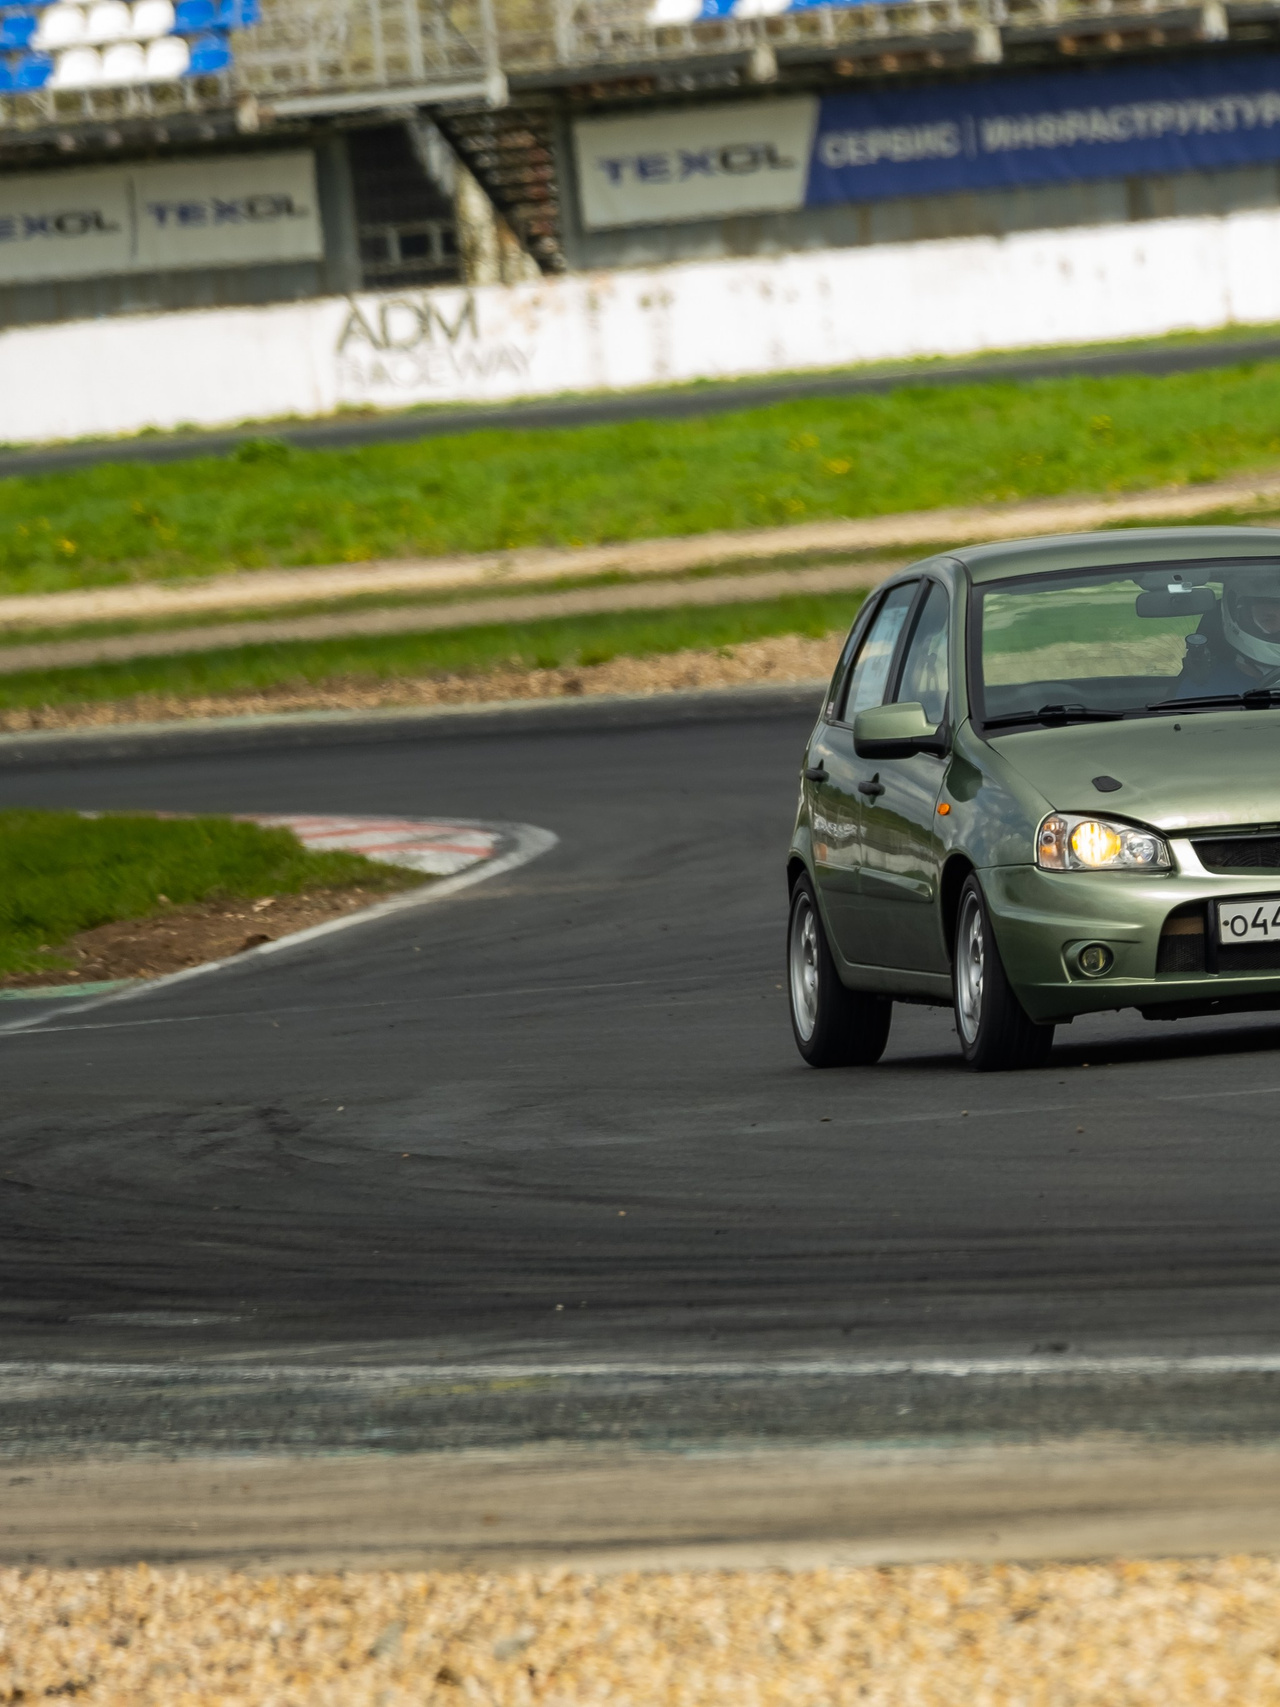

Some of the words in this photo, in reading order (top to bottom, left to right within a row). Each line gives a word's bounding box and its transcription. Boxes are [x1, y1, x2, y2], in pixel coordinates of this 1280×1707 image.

[596, 143, 796, 187] TEXOL
[821, 122, 962, 168] СЕРВИС
[148, 194, 309, 229] TEXOL
[336, 290, 478, 355] ADM
